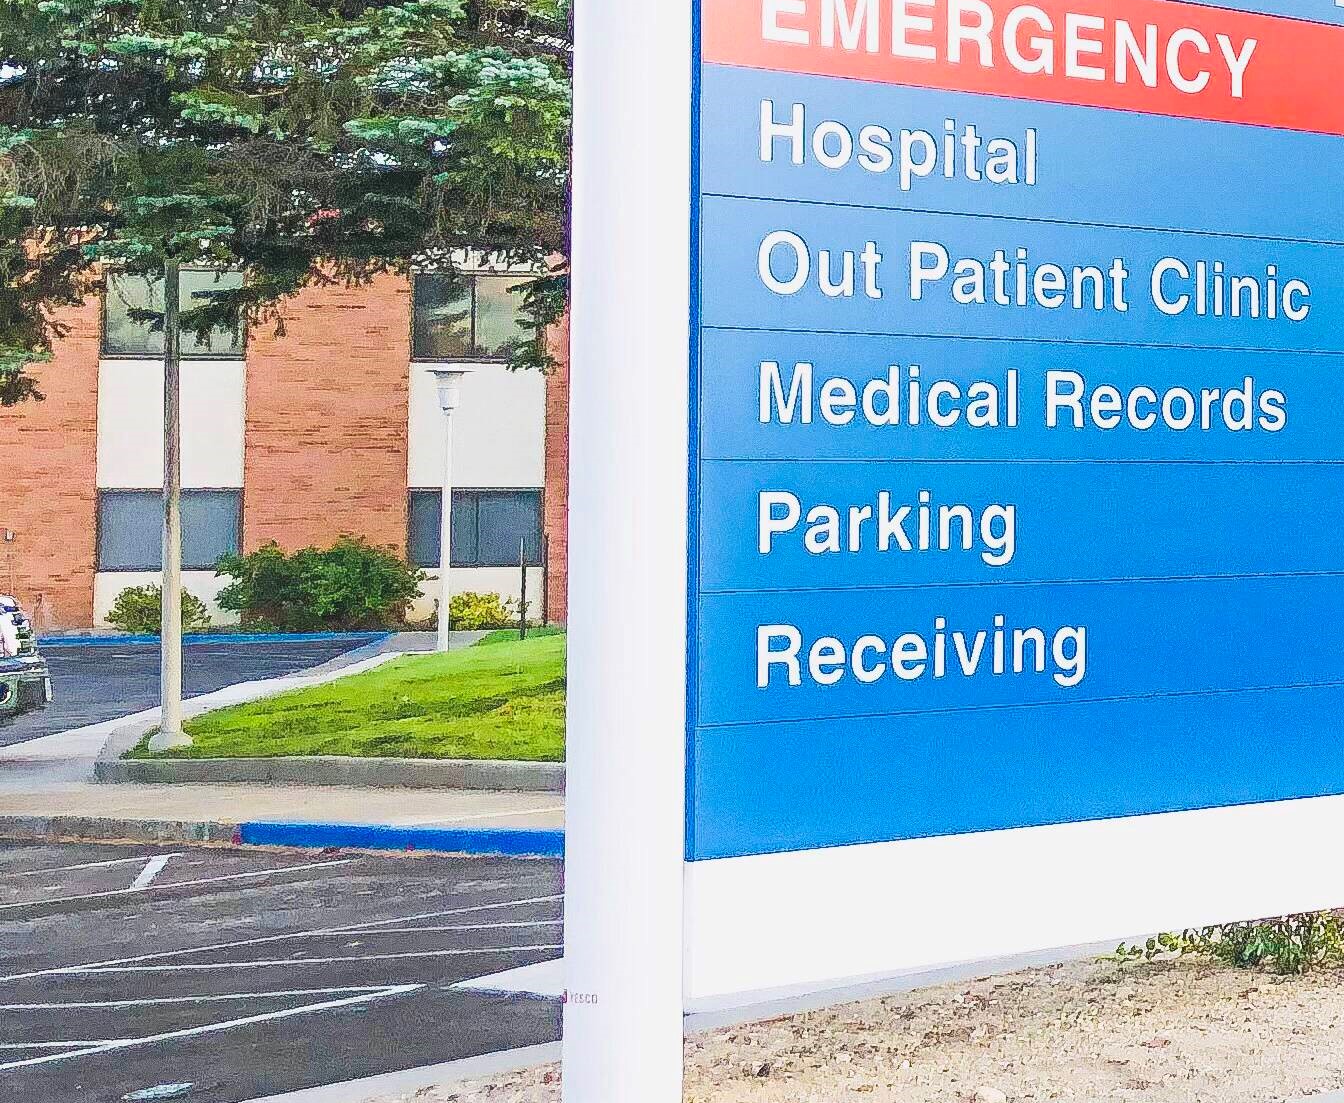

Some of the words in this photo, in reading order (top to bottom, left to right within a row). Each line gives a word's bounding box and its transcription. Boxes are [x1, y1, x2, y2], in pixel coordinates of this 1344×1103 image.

[760, 99, 1037, 192] Hospital
[758, 230, 882, 300] Out
[909, 240, 1128, 312] Patient
[1151, 257, 1311, 322] Clinic
[759, 361, 1018, 430] Medical
[1045, 371, 1288, 434] Records
[759, 491, 1017, 567] Parking
[757, 617, 1087, 688] Receiving
